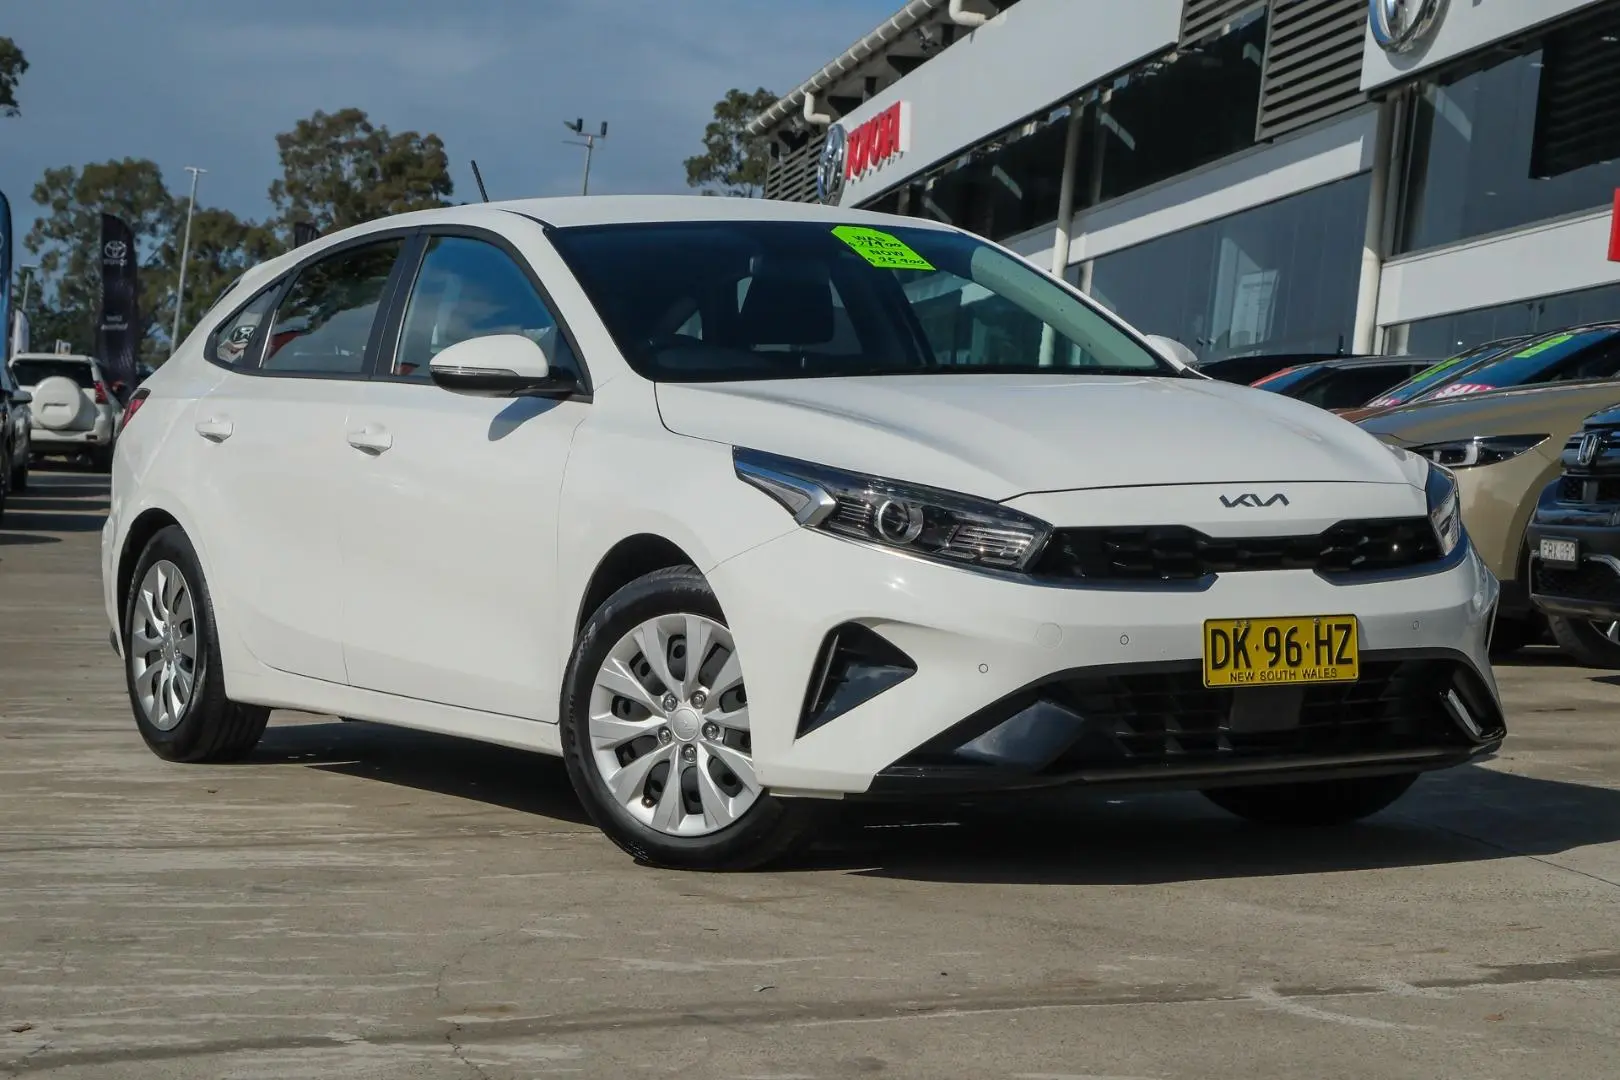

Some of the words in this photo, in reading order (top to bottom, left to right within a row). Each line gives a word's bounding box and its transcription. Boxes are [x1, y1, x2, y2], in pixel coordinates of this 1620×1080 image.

[868, 249, 905, 257] NOW
[1230, 671, 1255, 683] NEW
[1260, 669, 1296, 682] SOUTH
[1302, 667, 1337, 680] WALES
